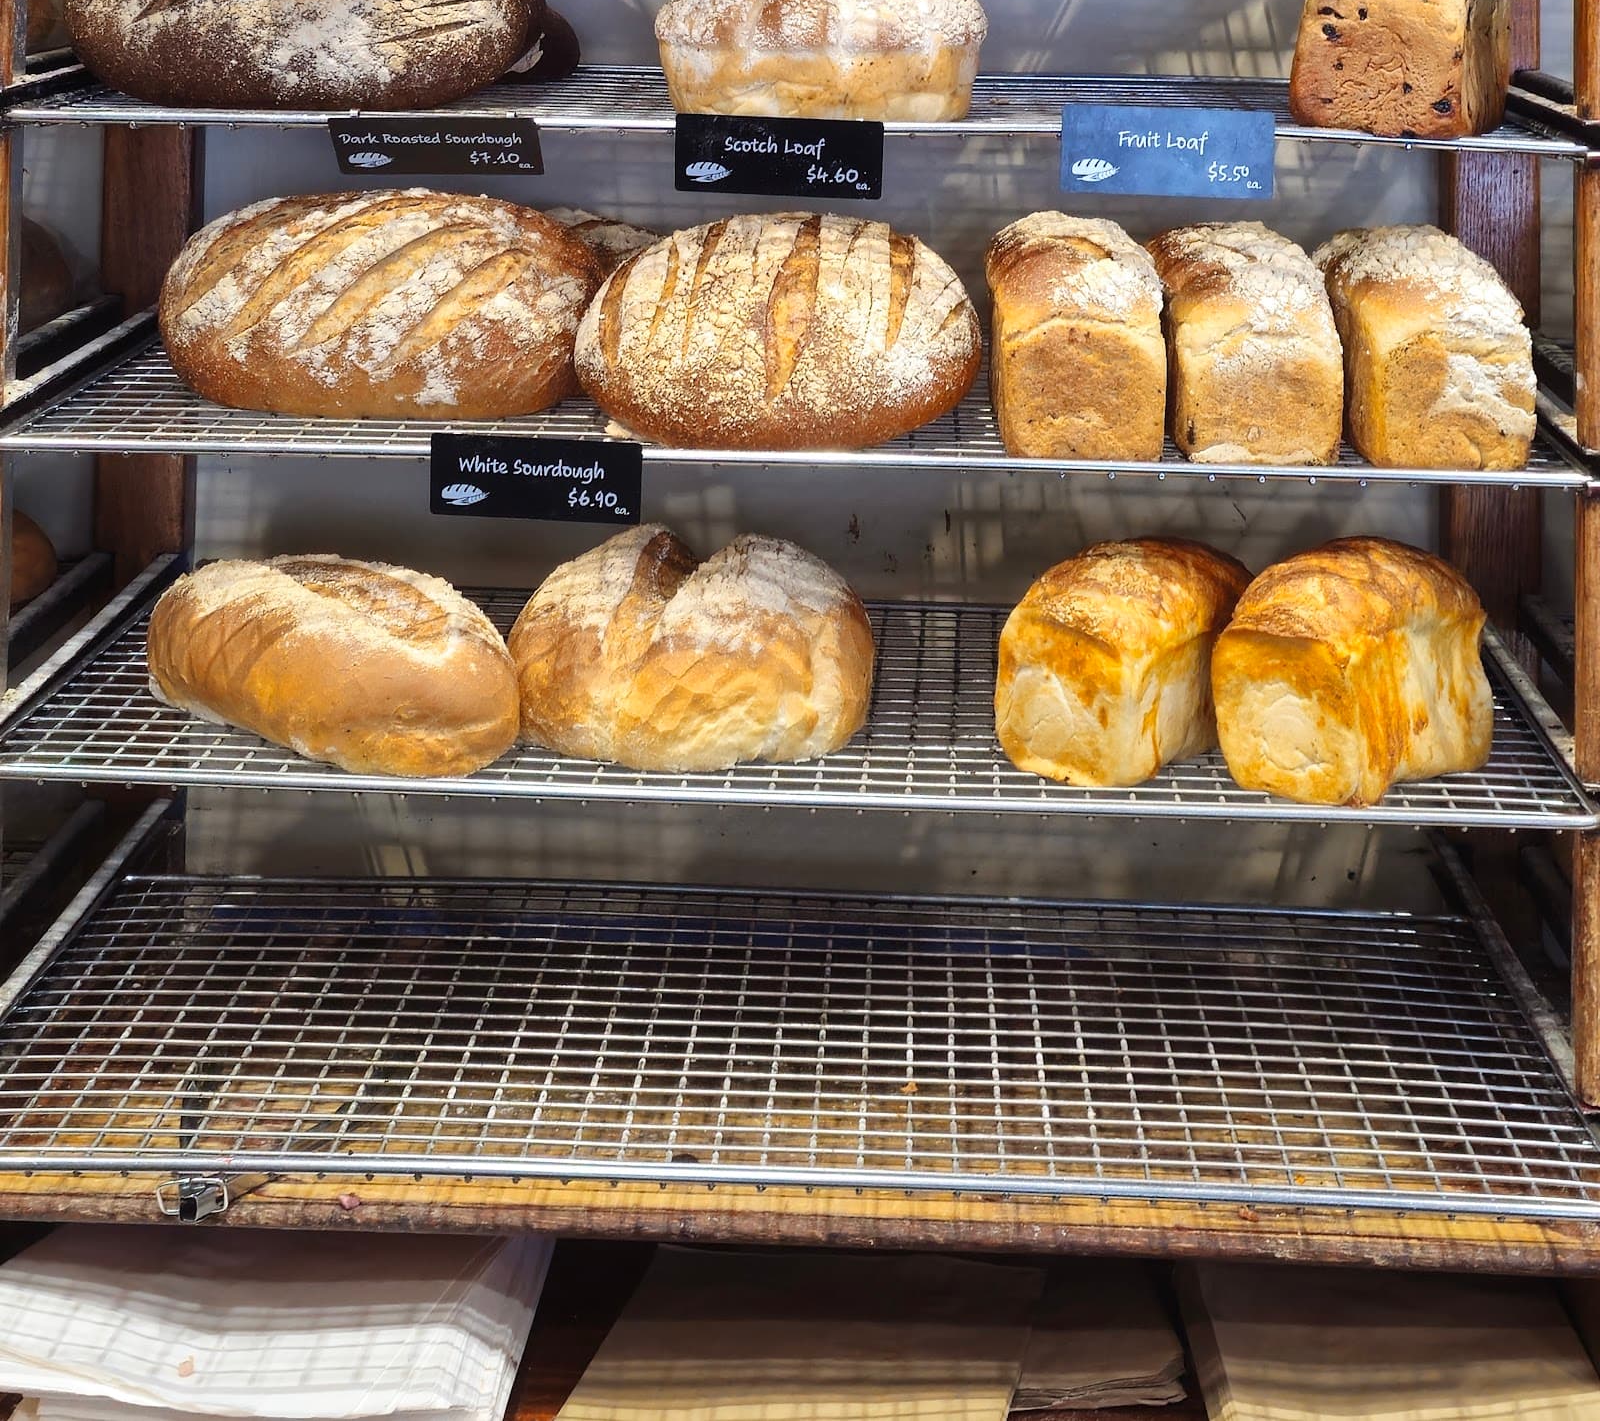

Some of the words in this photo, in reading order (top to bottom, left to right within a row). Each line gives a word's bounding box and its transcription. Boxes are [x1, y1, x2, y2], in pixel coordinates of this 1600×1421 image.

[338, 132, 380, 144] Dark
[383, 132, 440, 144] Roasted
[445, 132, 522, 147] Sourdough
[724, 136, 778, 153] Scotch
[784, 138, 826, 160] Loaf
[1118, 130, 1161, 148] Fruit
[1167, 130, 1209, 155] Loaf
[806, 164, 859, 184] $4.60
[856, 182, 871, 191] ea.
[1208, 161, 1250, 182] $5.50
[1246, 179, 1262, 189] ea.
[459, 455, 508, 474] White
[513, 459, 605, 484] Sourdough
[567, 487, 618, 507] $6.90
[615, 506, 630, 515] ea.
